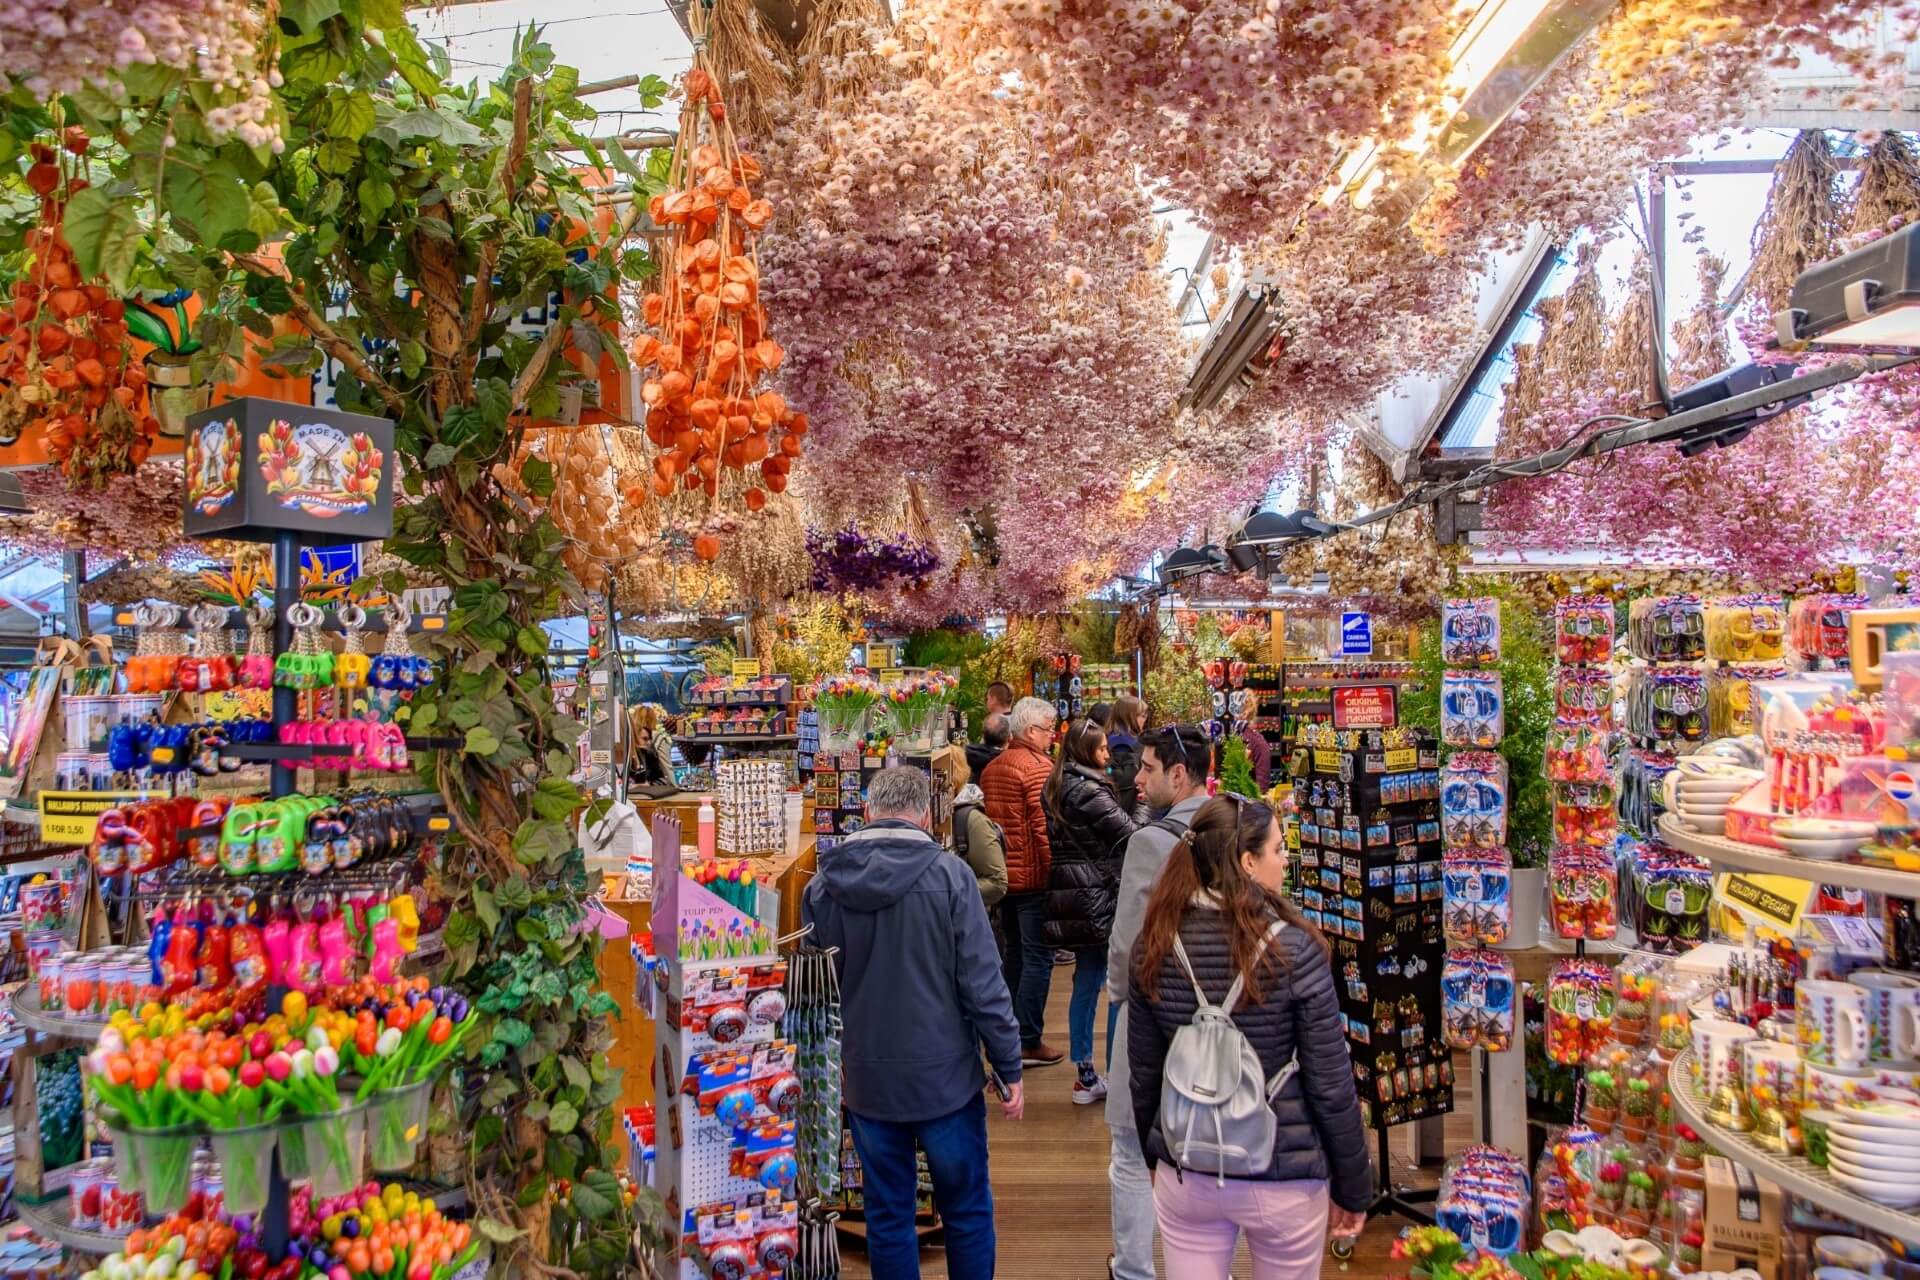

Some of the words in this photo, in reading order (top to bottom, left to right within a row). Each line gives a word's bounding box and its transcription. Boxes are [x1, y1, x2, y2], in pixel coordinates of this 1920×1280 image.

[299, 427, 330, 439] MADE
[332, 433, 346, 444] IN
[1345, 697, 1383, 706] ORIGINAL
[1345, 706, 1383, 715] HOLLAND
[1345, 714, 1383, 724] MAGNETS
[47, 800, 81, 813] HOLLAND'S
[52, 825, 66, 834] FOR
[1729, 879, 1761, 902] HOLIDAY
[1760, 893, 1791, 917] SPECIAL
[684, 907, 706, 917] TULIP
[708, 906, 724, 915] PEN
[1712, 1224, 1760, 1241] HOLLAND
